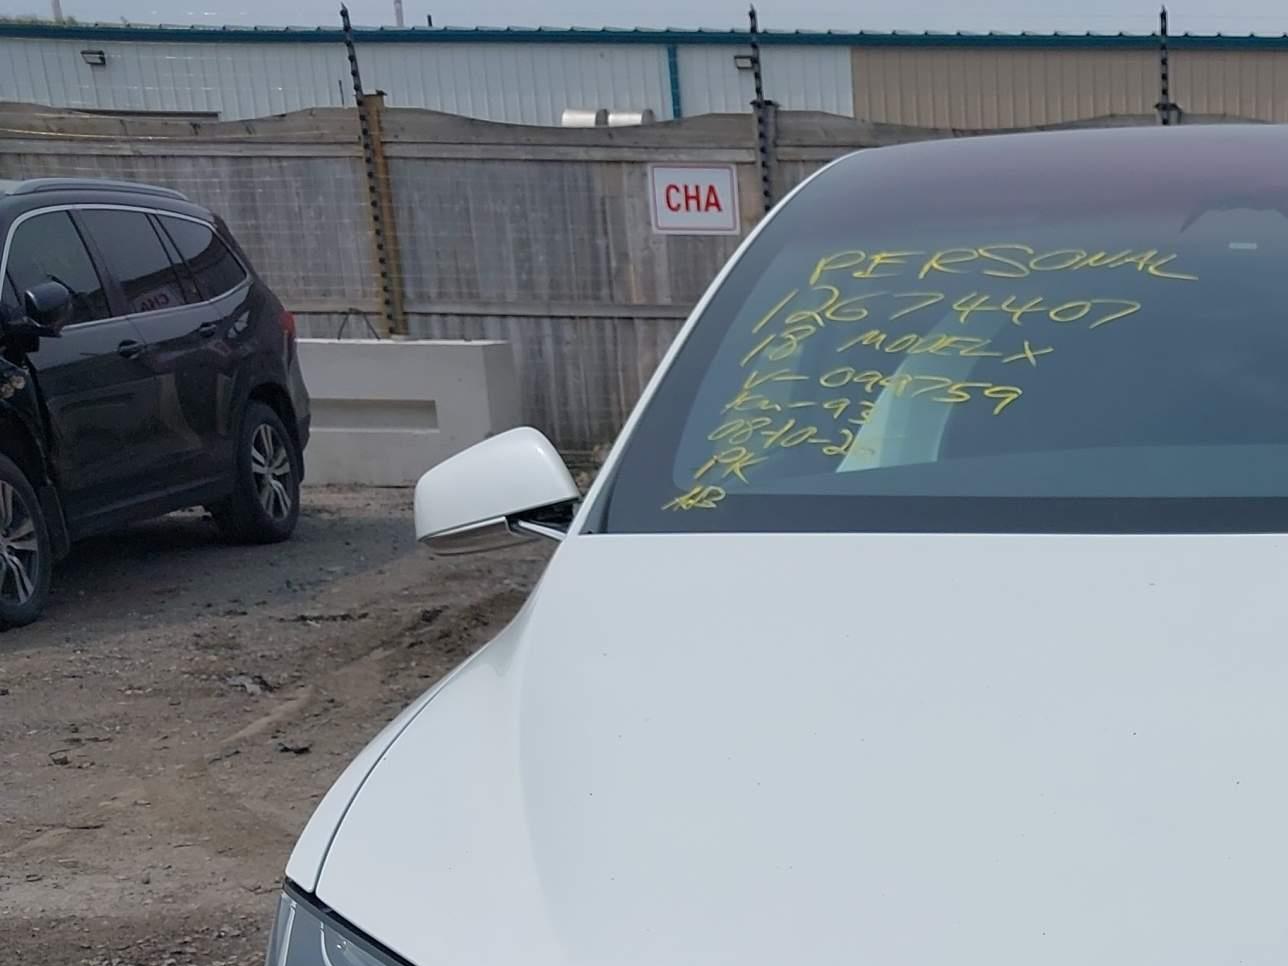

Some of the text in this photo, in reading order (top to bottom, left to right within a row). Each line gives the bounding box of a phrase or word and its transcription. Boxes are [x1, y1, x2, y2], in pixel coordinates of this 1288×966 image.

[665, 184, 722, 212] CHA
[809, 245, 1198, 284] PERSONAL
[752, 286, 1141, 332] 12674407
[740, 324, 816, 366] 18
[1002, 340, 1053, 366] X
